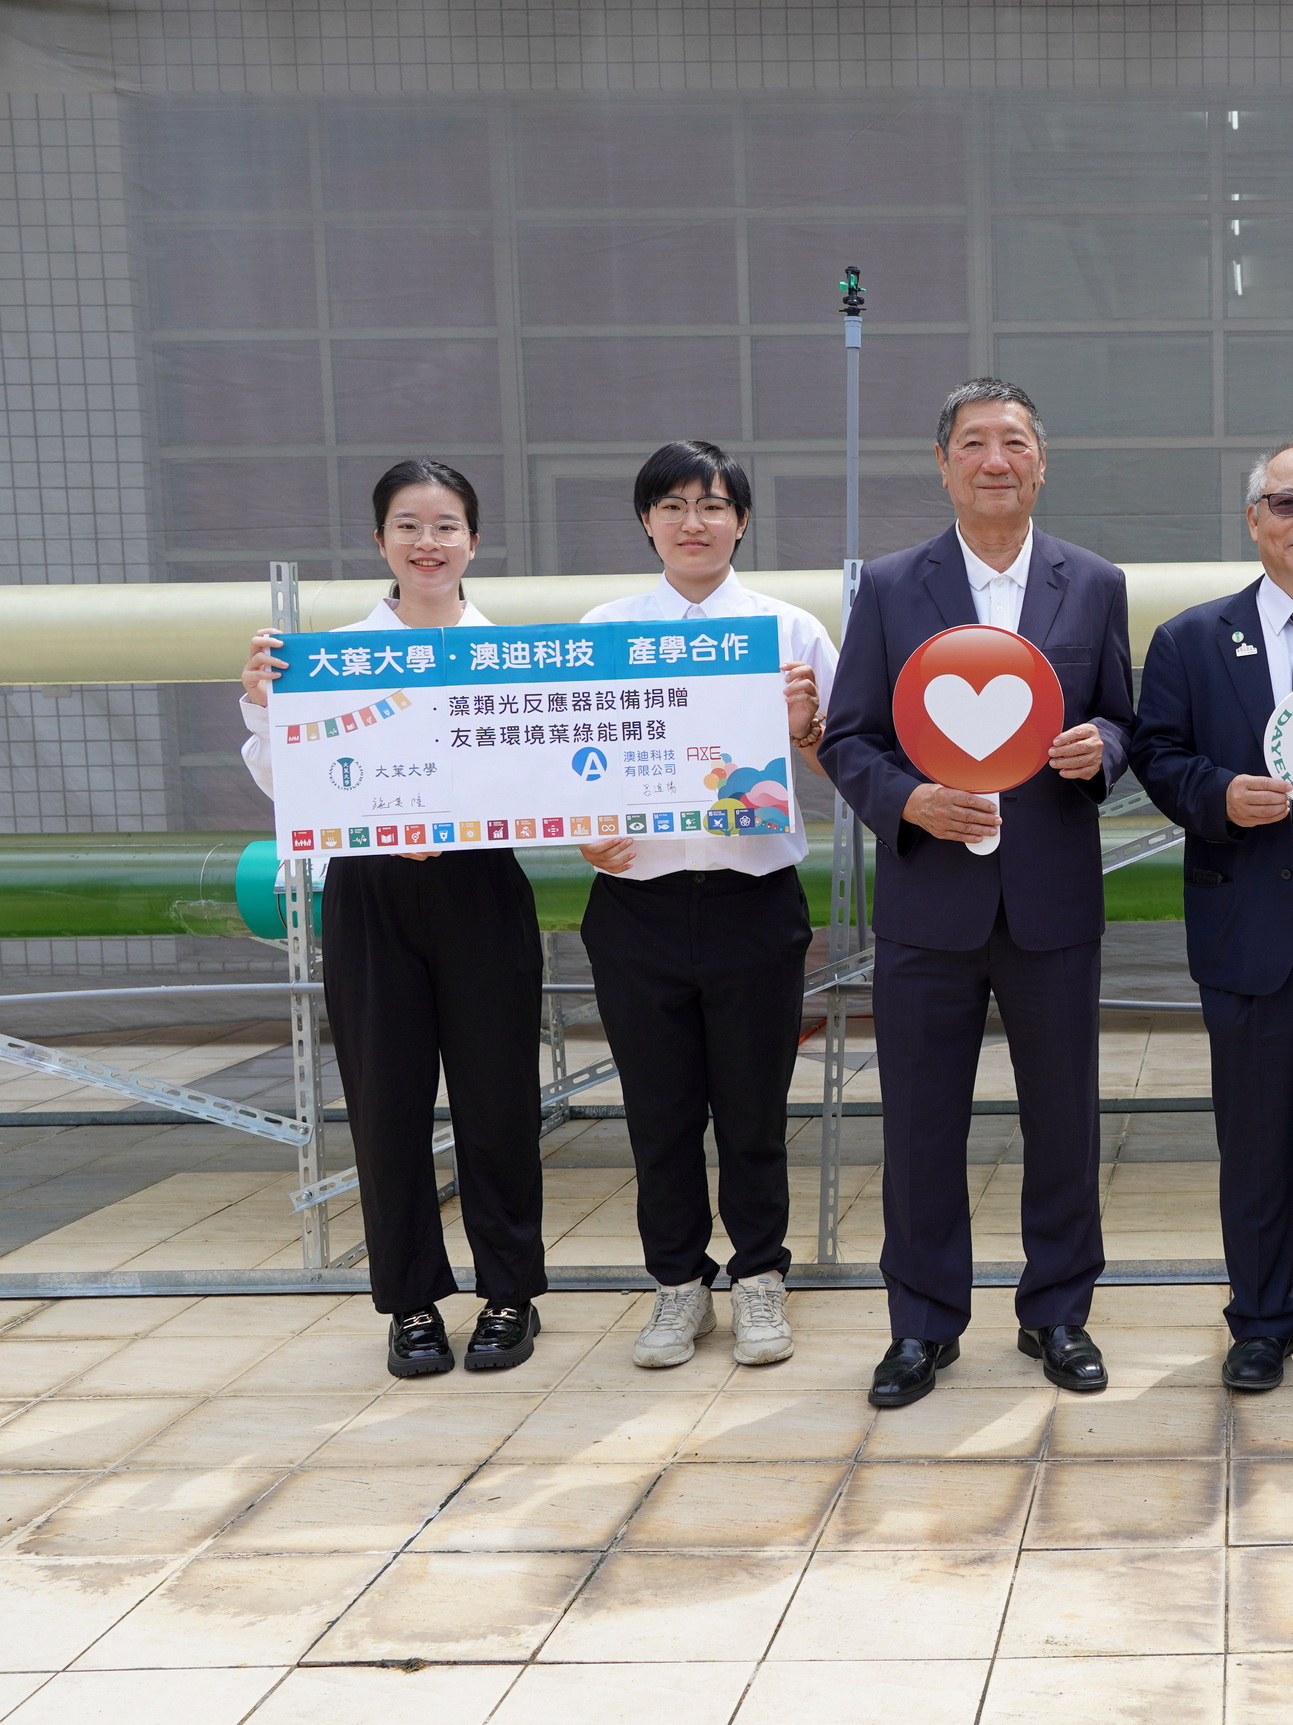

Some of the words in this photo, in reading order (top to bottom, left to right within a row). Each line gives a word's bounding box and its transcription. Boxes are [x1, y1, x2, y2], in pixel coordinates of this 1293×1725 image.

[627, 633, 749, 665] 產學合作
[449, 687, 689, 716] 藻類光反應器設備捐贈
[450, 720, 667, 748] 友善環境葉綠能開發
[623, 749, 676, 763] 澳迪科技
[375, 762, 438, 778] 大葉大學
[624, 764, 676, 777] 有限公司
